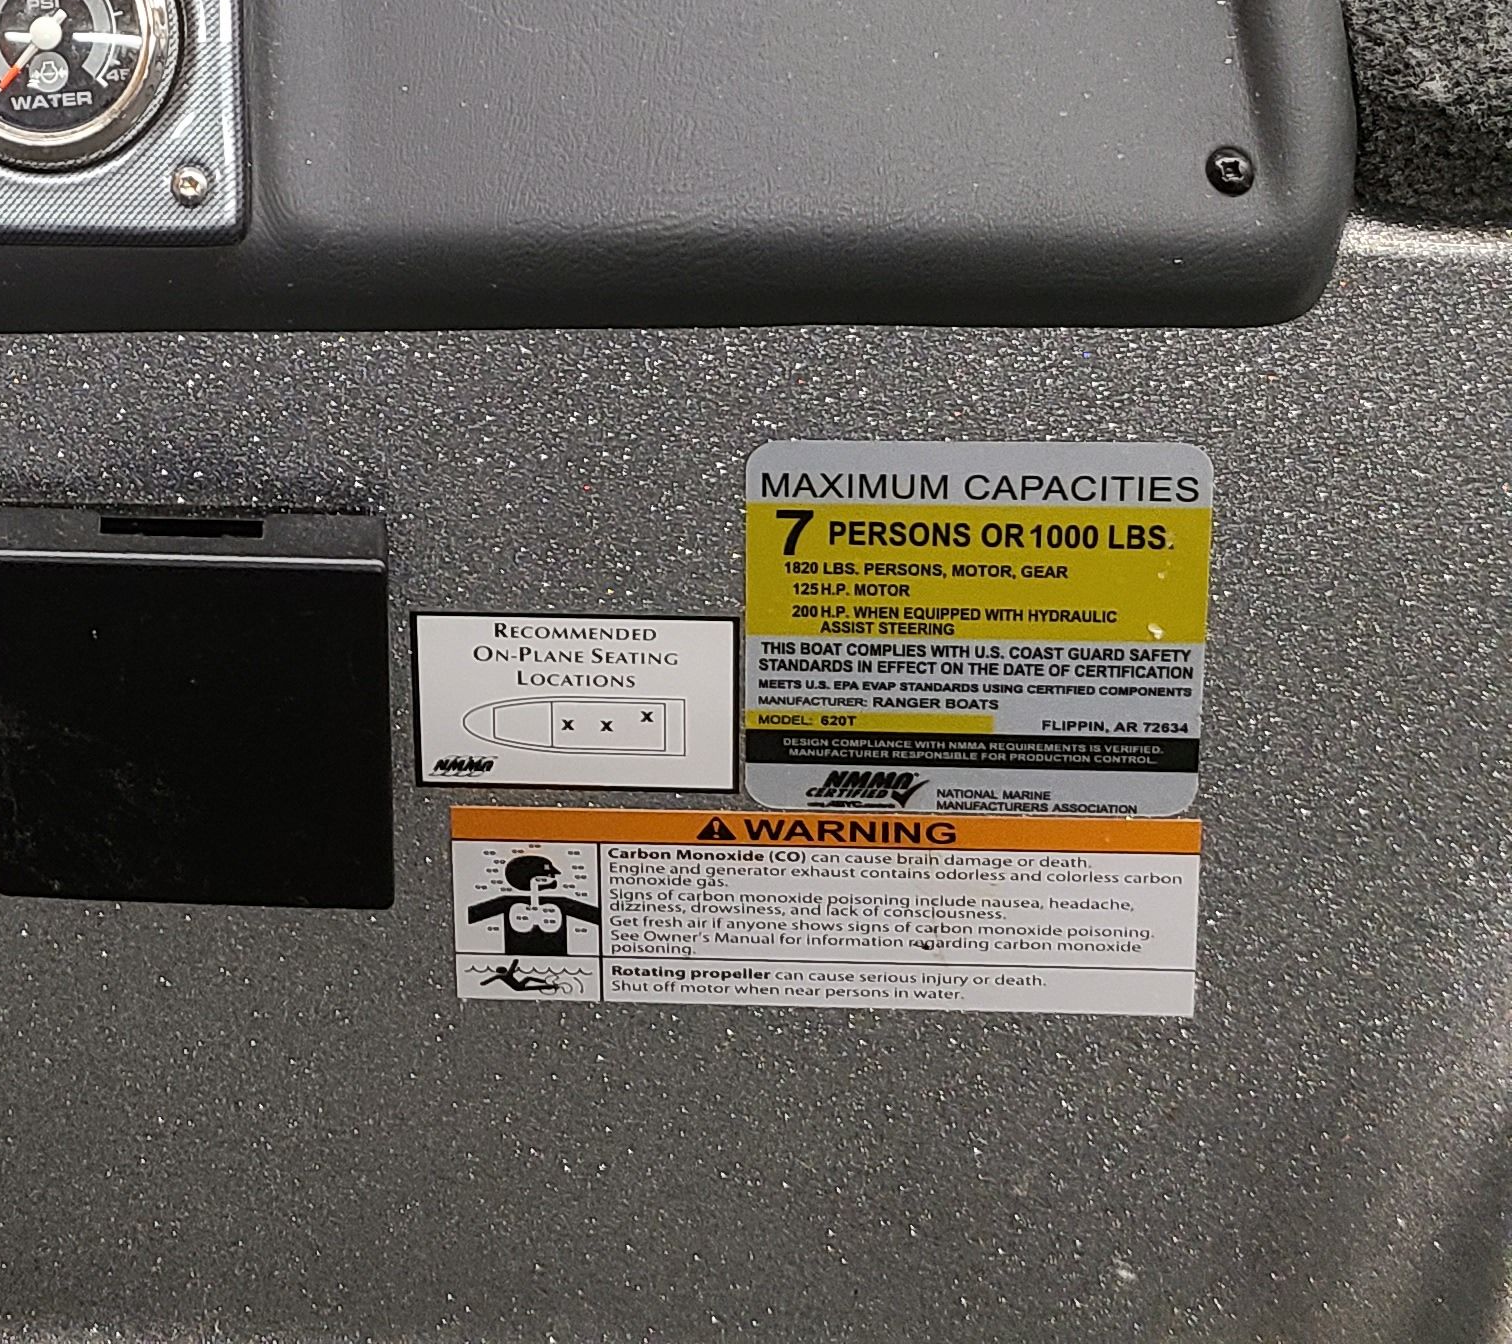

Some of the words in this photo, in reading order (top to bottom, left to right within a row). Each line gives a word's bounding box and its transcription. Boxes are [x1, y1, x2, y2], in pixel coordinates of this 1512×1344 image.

[11, 92, 93, 111] WATER
[761, 472, 949, 500] MAXIMUM
[964, 474, 1200, 503] CAPACITIES
[776, 509, 814, 556] 7
[829, 520, 971, 547] PERSONS
[981, 523, 1024, 548] OR
[1030, 524, 1098, 549] 1000
[1108, 524, 1174, 550] LBS.
[784, 561, 819, 574] 1820
[823, 562, 859, 575] LBS.
[864, 562, 947, 579] PERSONS,
[952, 564, 1017, 579] MOTOR,
[1021, 565, 1068, 578] GEAR
[793, 583, 819, 595] 125
[821, 583, 850, 596] H.P.
[854, 583, 910, 597] MOTOR
[792, 605, 818, 618] 200
[821, 606, 850, 618] H.P.
[854, 606, 899, 619] WHEN
[904, 607, 981, 621] EQUIPPED
[985, 609, 1023, 622] WITH
[1028, 609, 1117, 623] HYDRAULIC
[494, 622, 657, 641] RECOMMENDED
[820, 621, 874, 634] ASSIST
[879, 622, 955, 635] STEERING
[473, 645, 584, 663] ON-PLANE
[591, 648, 678, 666] SEATING
[761, 642, 796, 655] THIS
[800, 642, 842, 656] BOAT
[847, 643, 926, 657] COMPLIES
[930, 645, 970, 658] WITH
[974, 646, 1005, 659] U.S.
[1009, 646, 1064, 660] COAST
[1068, 647, 1125, 661] GUARD
[1129, 648, 1191, 662] SAFETY
[758, 659, 852, 673] STANDARDS
[858, 660, 872, 673] IN
[877, 661, 937, 674] EFFECT
[941, 662, 964, 675] ON
[968, 663, 999, 676] THE
[1003, 664, 1044, 676] DATE
[1048, 664, 1070, 677] OF
[1074, 665, 1193, 679] CERTIFICATION
[517, 670, 635, 688] LOCATIONS
[758, 696, 867, 708] MANUFACTURER:
[873, 697, 941, 709] RANGER
[945, 699, 999, 710] BOATS
[758, 715, 813, 726] MODEL:
[821, 715, 856, 726] 620T
[1042, 720, 1109, 734] FLIPPIN,
[1114, 722, 1138, 733] AR
[1143, 722, 1189, 734] 72634
[805, 787, 889, 799] CERTIFIED
[936, 789, 998, 800] NATIONAL
[1002, 790, 1051, 801] MARINE
[743, 818, 957, 845] WARNING
[608, 848, 671, 861] Carbon
[676, 849, 765, 863] Monoxide
[768, 850, 806, 864] (CO)
[811, 854, 839, 864] can
[845, 855, 893, 865] cause
[897, 853, 939, 866] brain
[944, 854, 1013, 869] damage
[1017, 857, 1035, 867] or
[1040, 855, 1092, 868] death.
[611, 965, 686, 981] Rotating
[691, 967, 771, 982] propeller
[775, 971, 804, 981] can
[808, 972, 854, 983] cause
[859, 972, 917, 984] serious
[921, 972, 968, 987] injury
[973, 976, 991, 985] or
[995, 974, 1047, 987] death.
